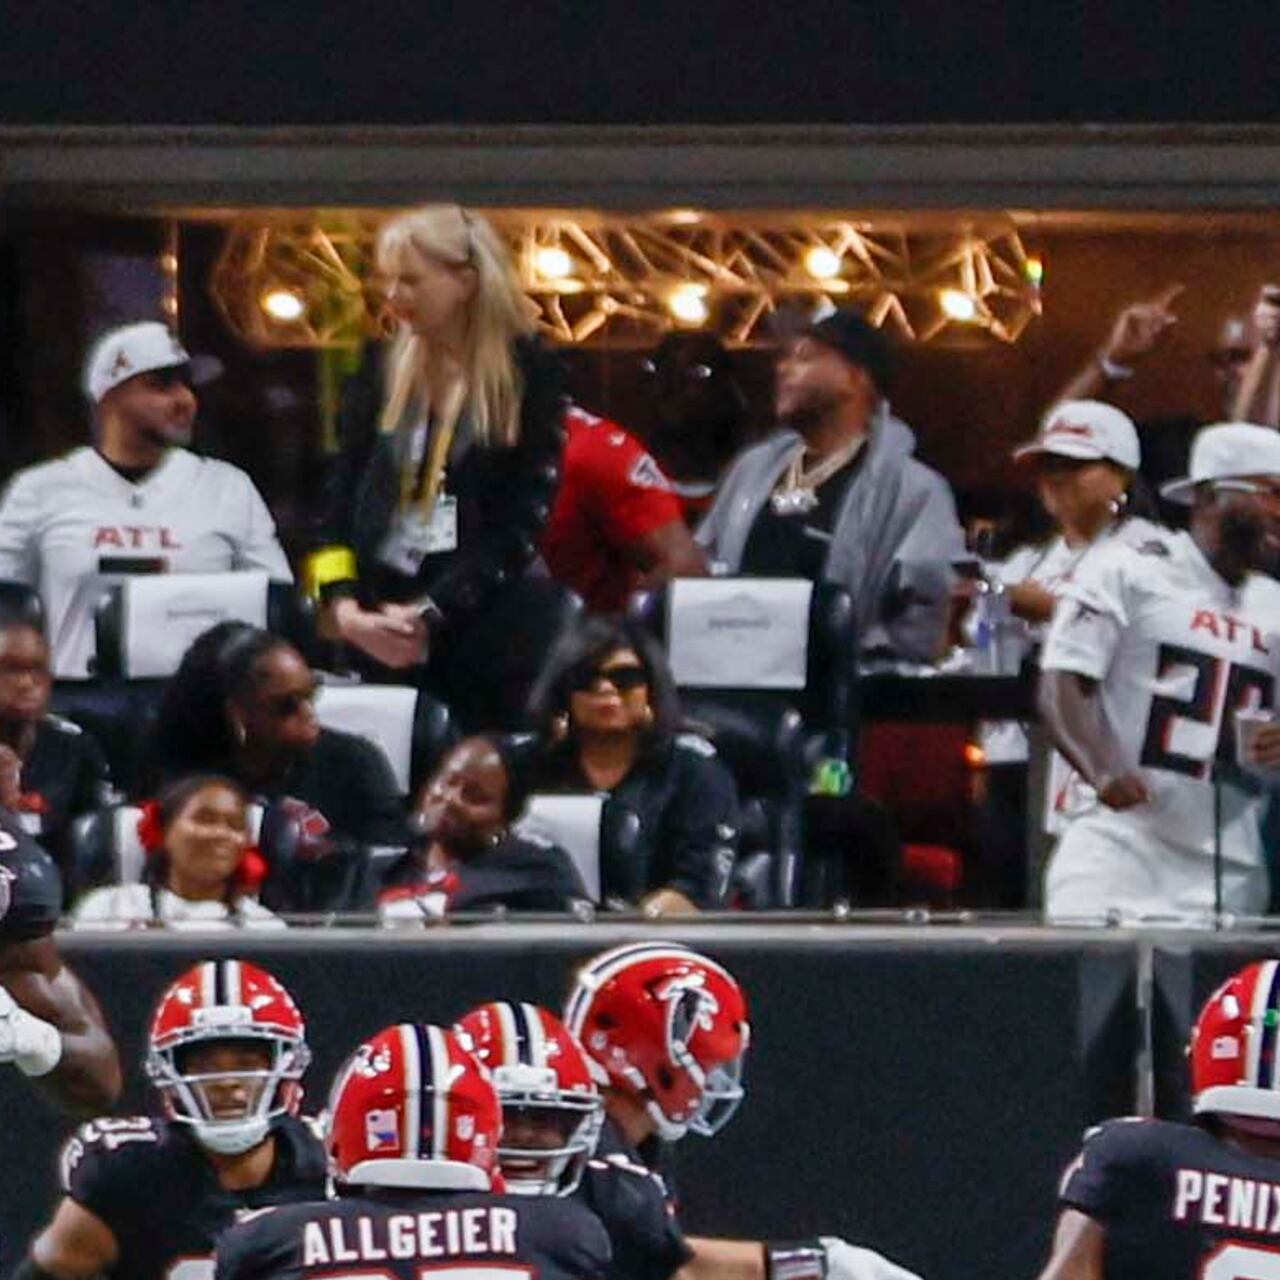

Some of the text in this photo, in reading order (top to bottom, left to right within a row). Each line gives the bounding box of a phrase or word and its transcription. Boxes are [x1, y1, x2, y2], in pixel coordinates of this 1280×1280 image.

[94, 522, 183, 549] ATL
[1190, 609, 1270, 656] ATL
[302, 1205, 519, 1267] ALLGEIER
